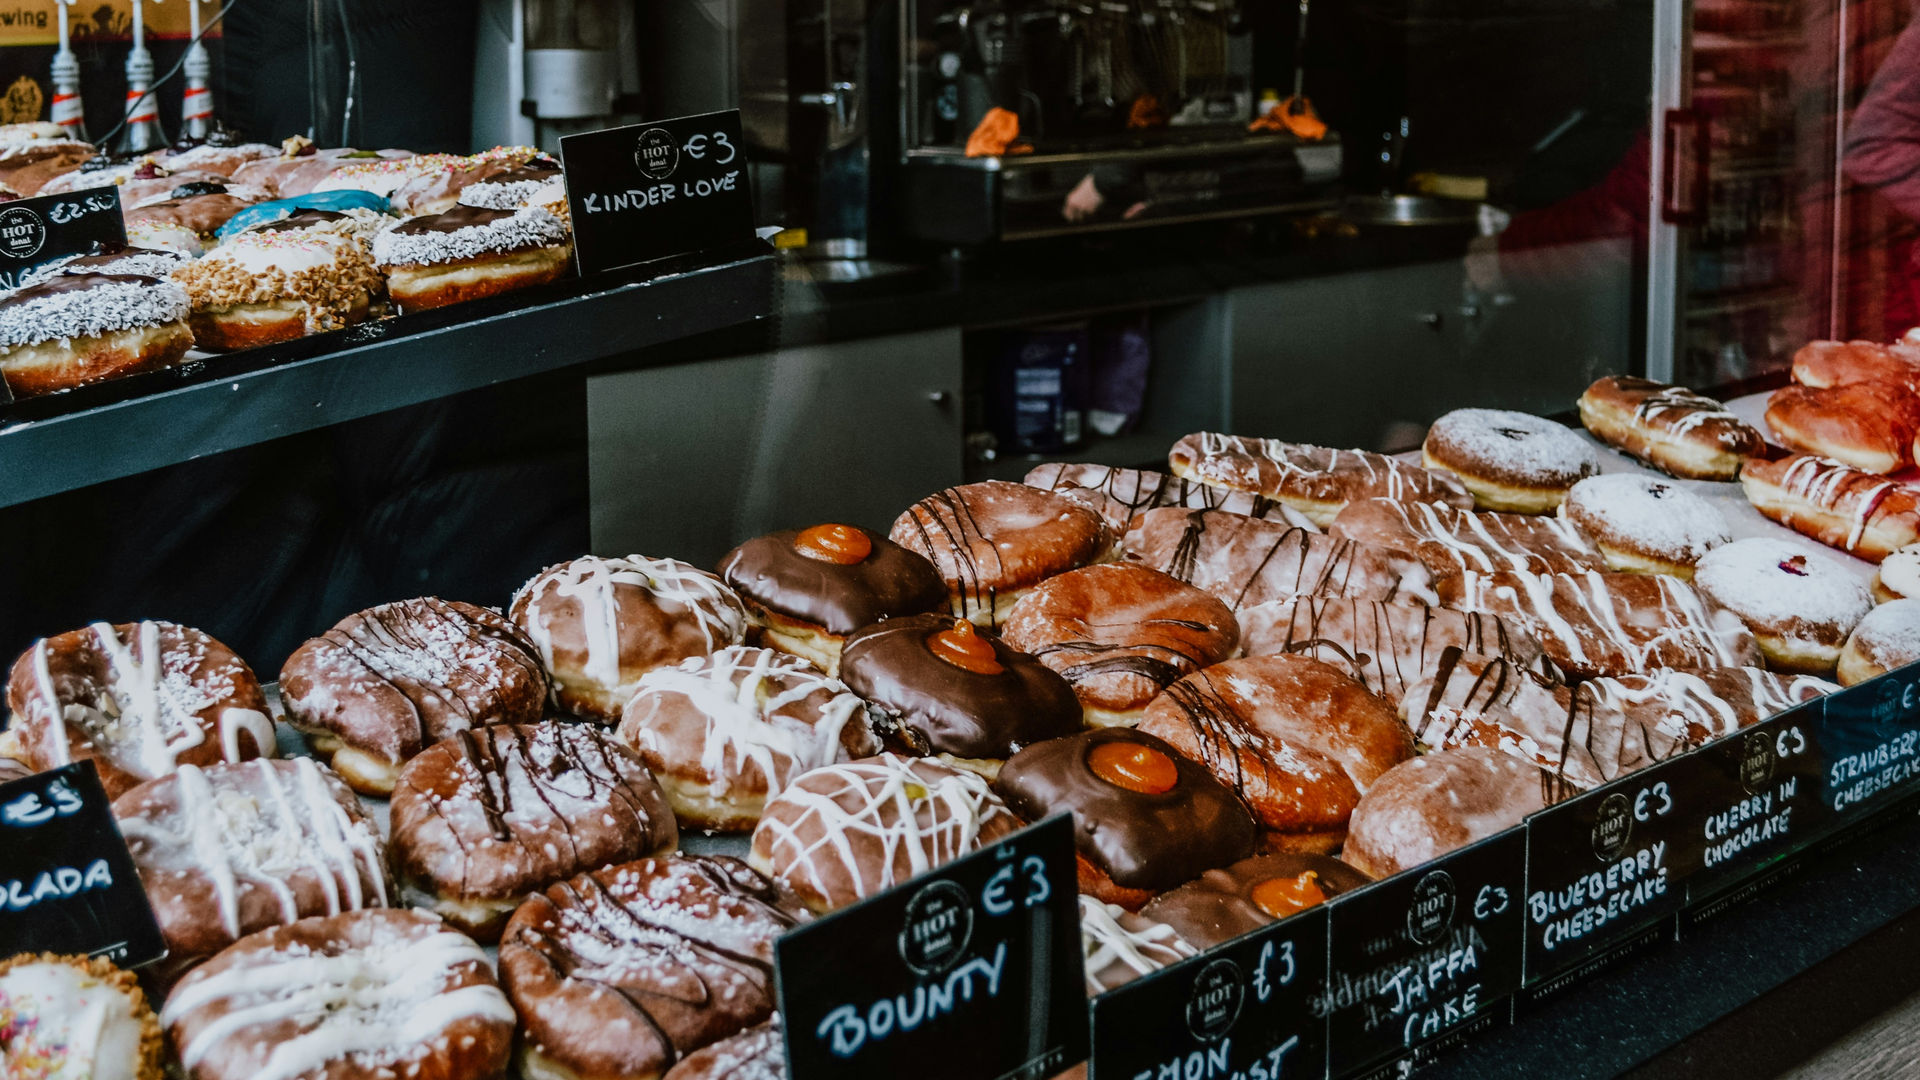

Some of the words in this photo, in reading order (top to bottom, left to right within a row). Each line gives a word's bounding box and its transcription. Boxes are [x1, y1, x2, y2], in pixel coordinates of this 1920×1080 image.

[642, 145, 670, 159] HOT
[682, 131, 736, 165] €3
[584, 183, 676, 214] KINDER
[684, 170, 740, 198] LOVE
[1, 223, 36, 239] HOT
[1633, 781, 1673, 822] €3
[1704, 790, 1772, 840] CHERRY
[1779, 776, 1798, 802] IN
[1599, 814, 1626, 837] HOT
[1704, 806, 1793, 868] CHOCOLATE
[1528, 840, 1666, 924] BLUEBERRY
[912, 905, 958, 943] HOT
[1416, 892, 1448, 918] HOT
[1543, 867, 1668, 950] CHEESECAKE
[817, 942, 1007, 1057] BOUNTY
[1197, 983, 1235, 1012] HOT
[1379, 945, 1478, 1014] JAFFA
[1404, 983, 1481, 1047] CAKE
